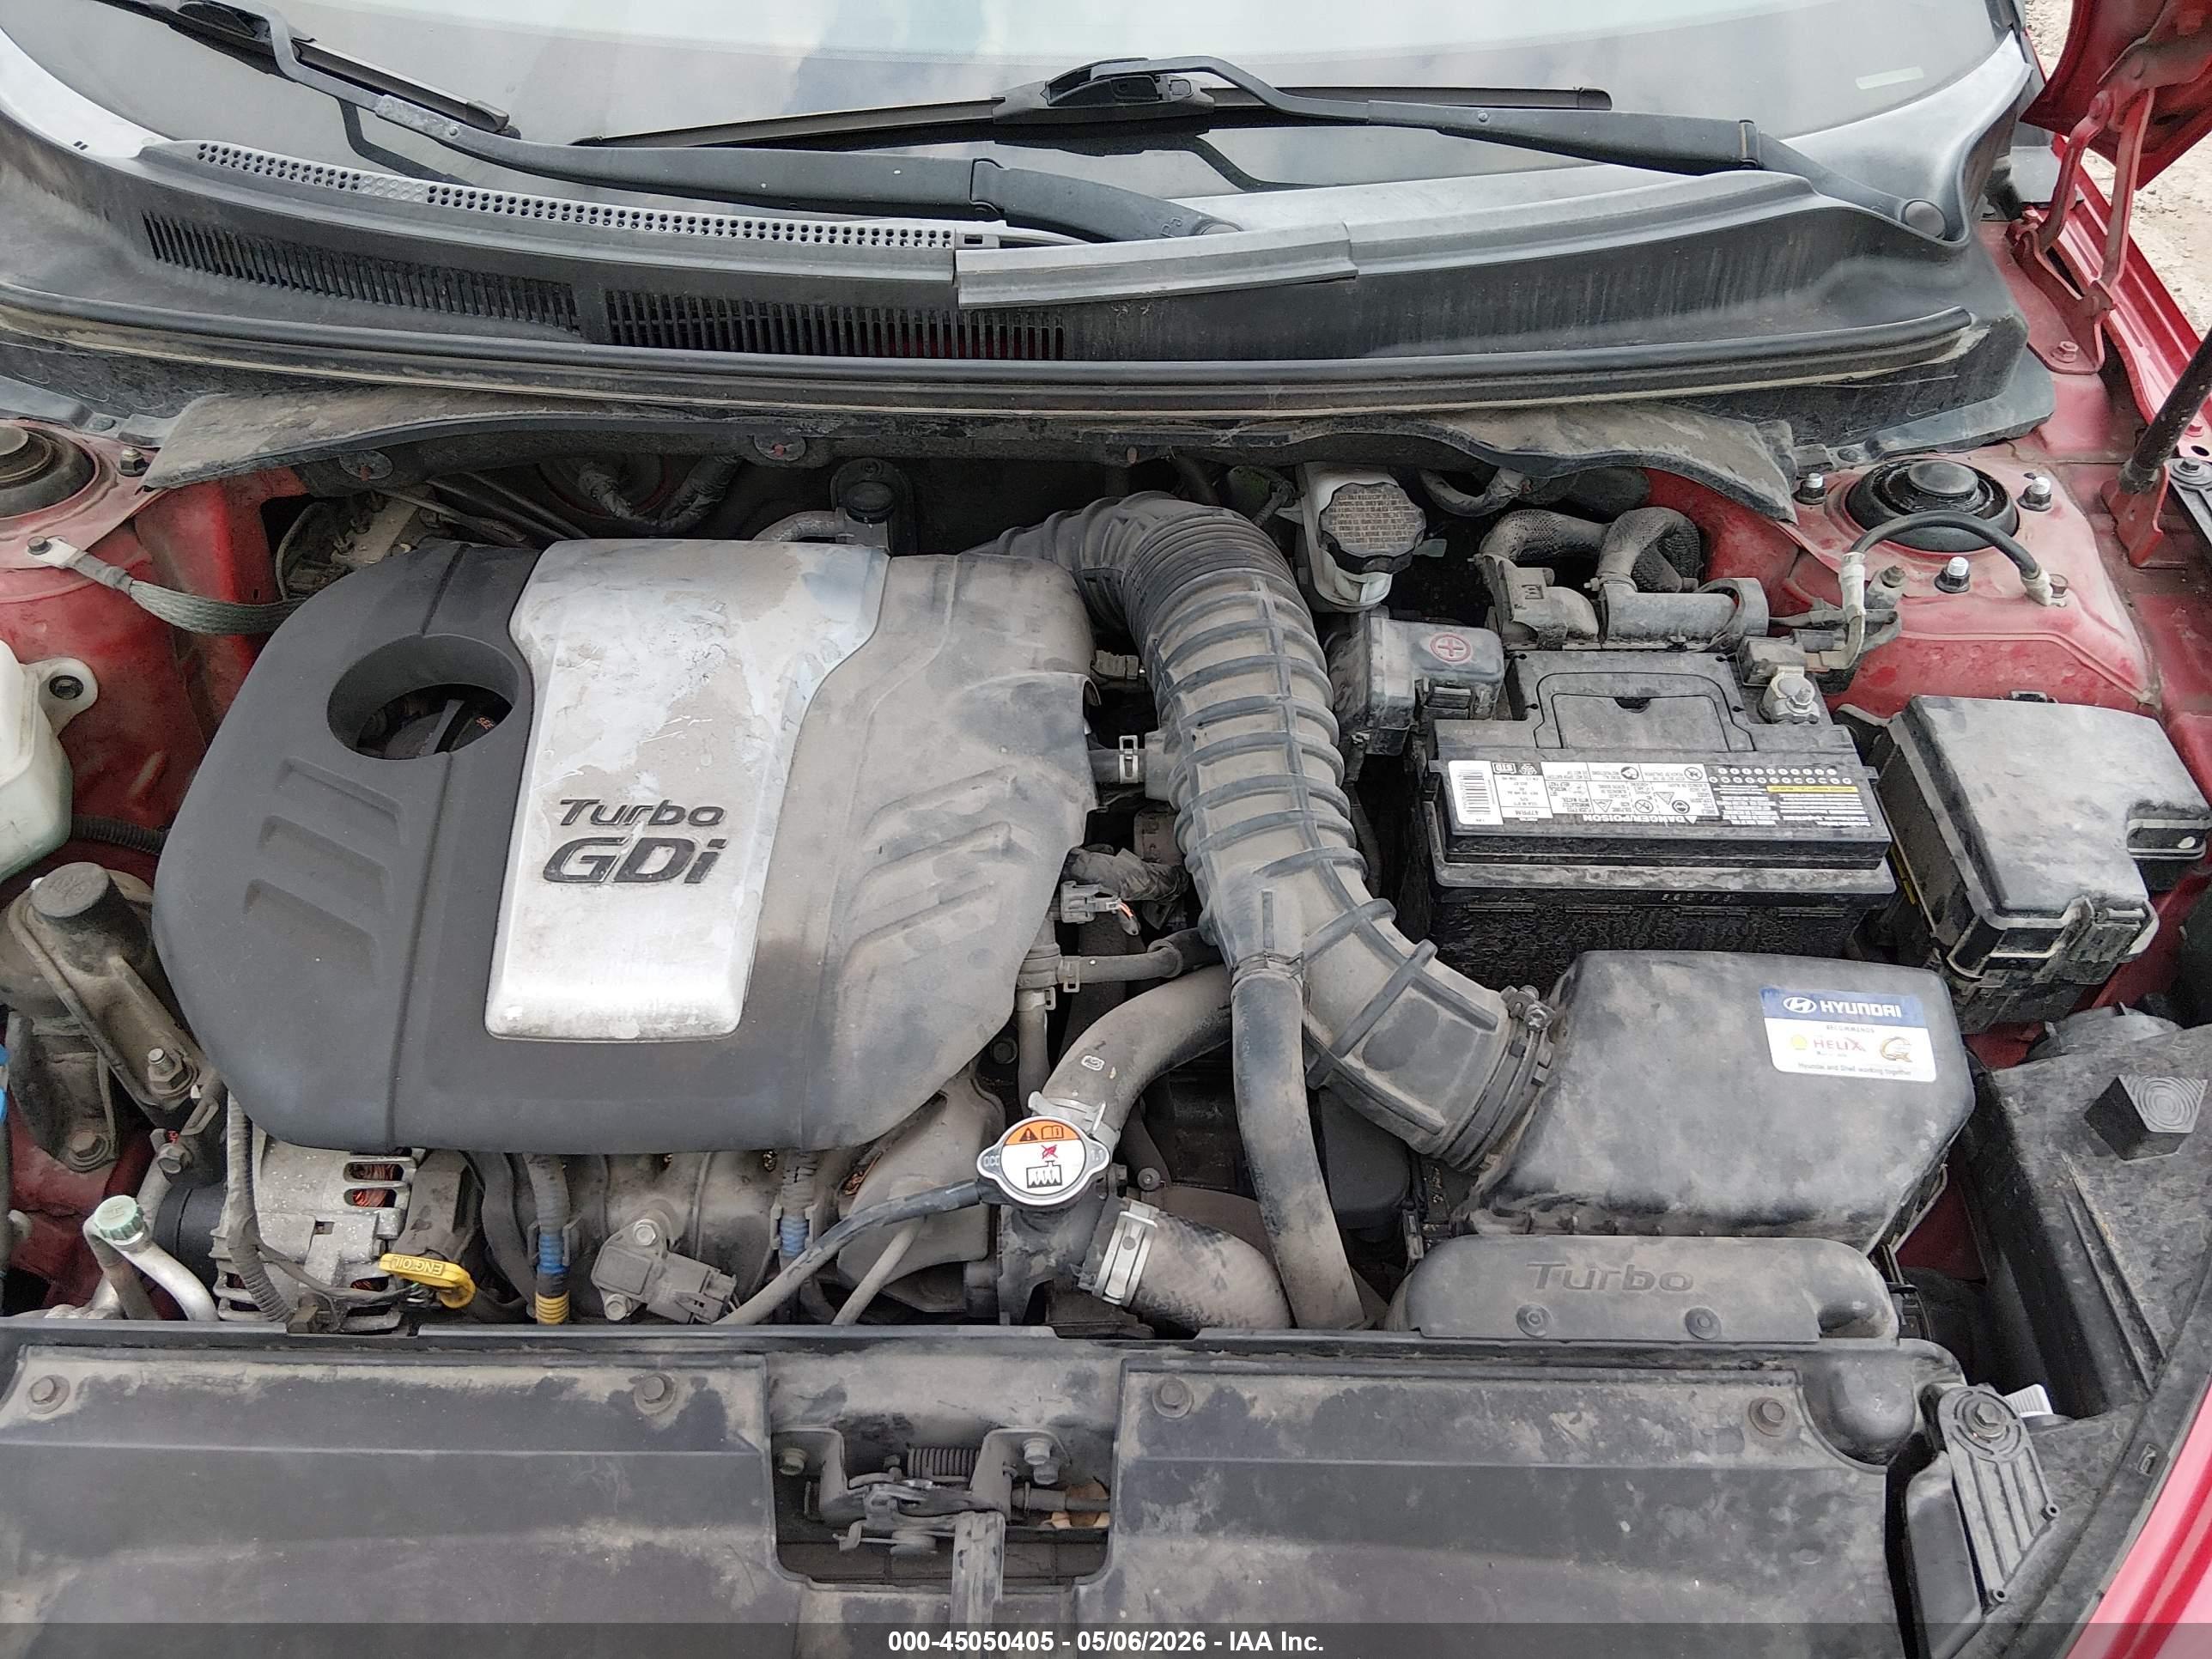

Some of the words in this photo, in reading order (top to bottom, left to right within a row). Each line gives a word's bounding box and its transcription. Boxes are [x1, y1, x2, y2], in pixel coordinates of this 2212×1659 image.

[560, 799, 726, 826] Turbo
[543, 837, 728, 884] GDi
[1820, 1000, 1903, 1019] HYUNDAI
[1814, 1036, 1867, 1053] HELIX
[392, 1256, 412, 1269] OIL
[416, 1261, 444, 1275] ENG
[1525, 1262, 1695, 1292] Turbo
